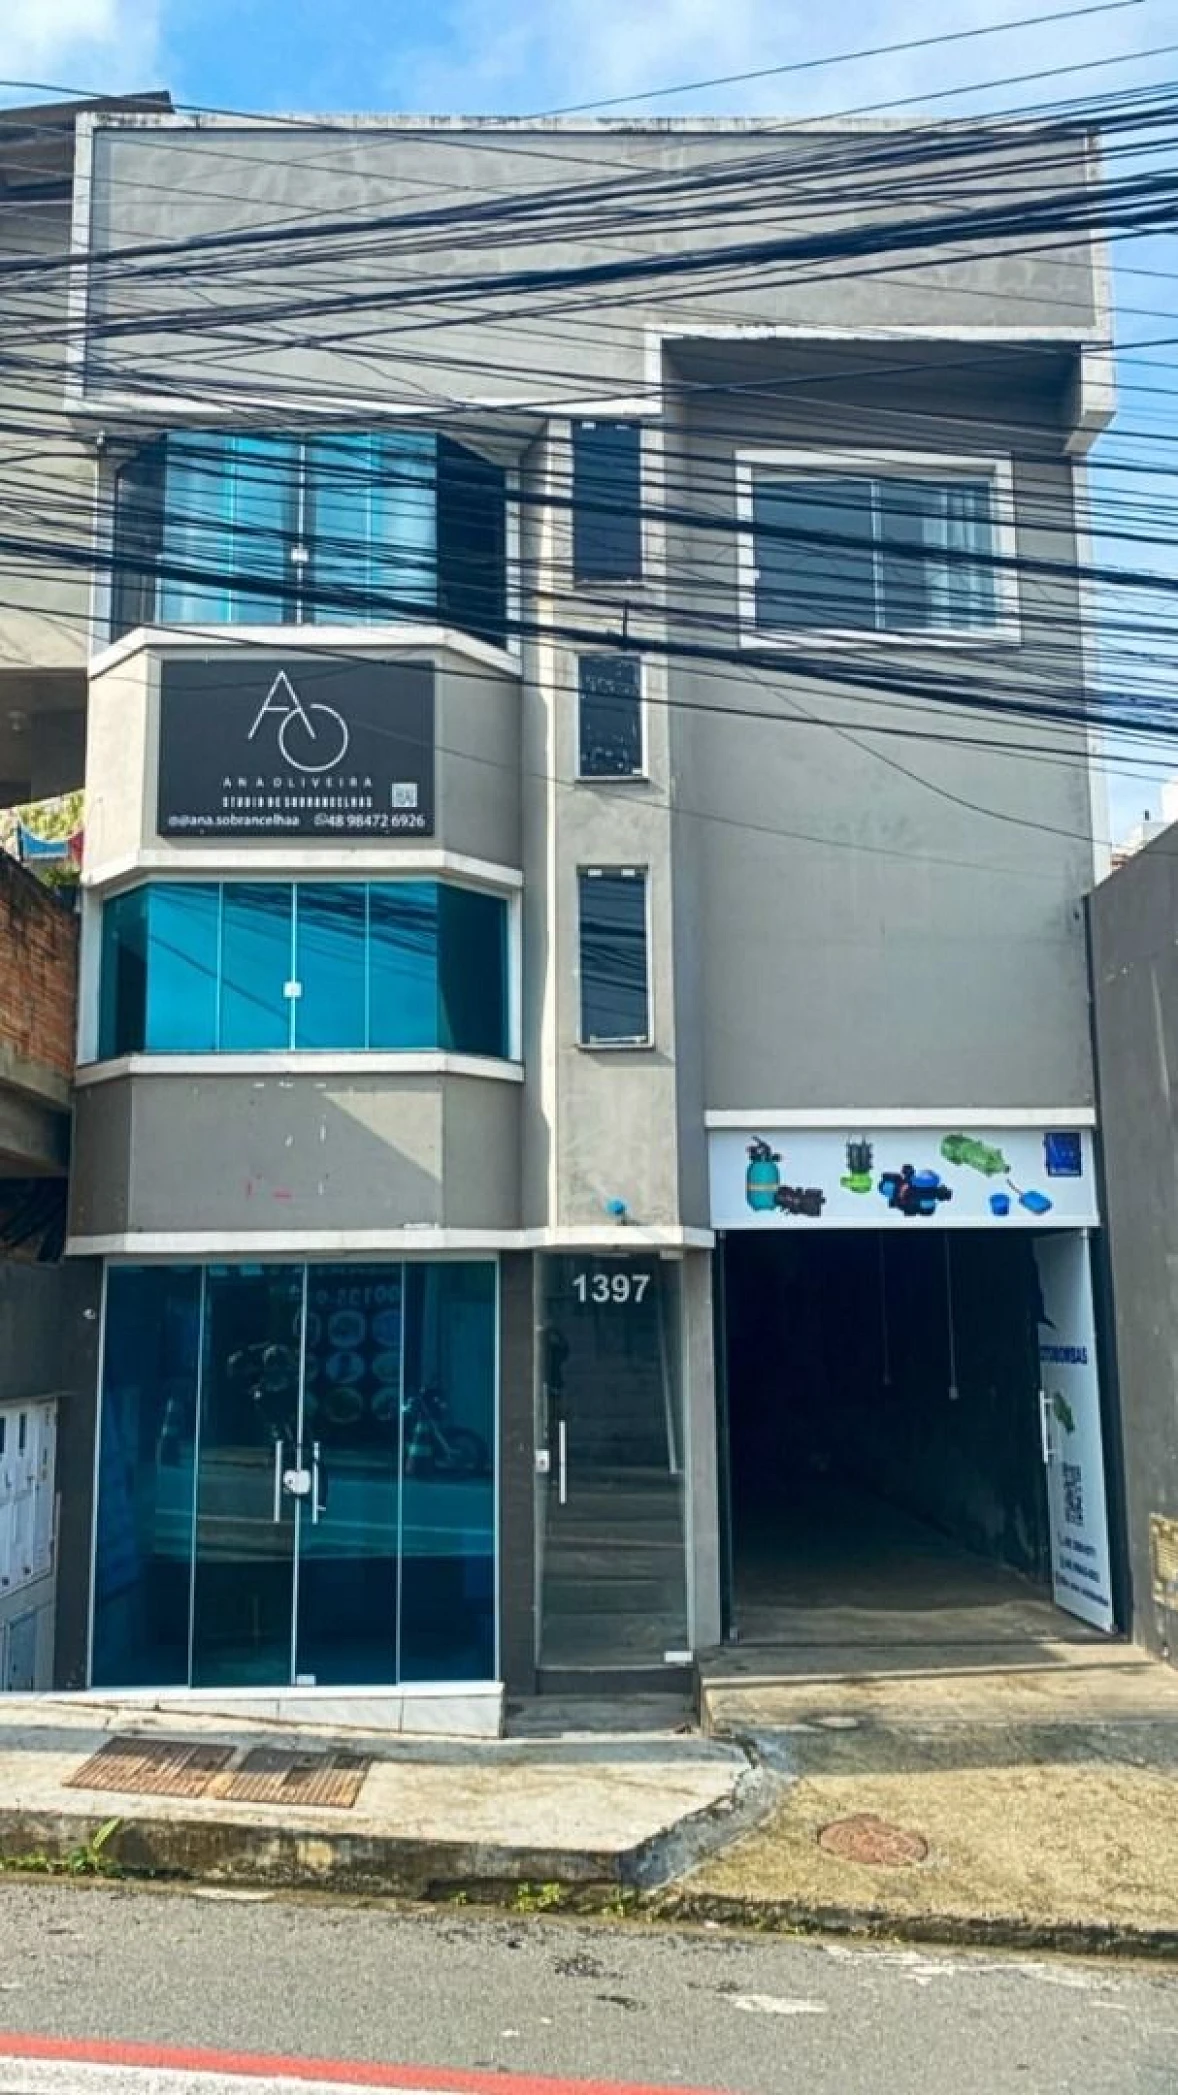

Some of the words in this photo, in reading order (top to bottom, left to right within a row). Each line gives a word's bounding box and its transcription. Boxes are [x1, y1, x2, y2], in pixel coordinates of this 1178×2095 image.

[327, 814, 345, 827] 48
[347, 814, 389, 828] 98472
[391, 814, 425, 827] 6926
[572, 1273, 651, 1303] 1397
